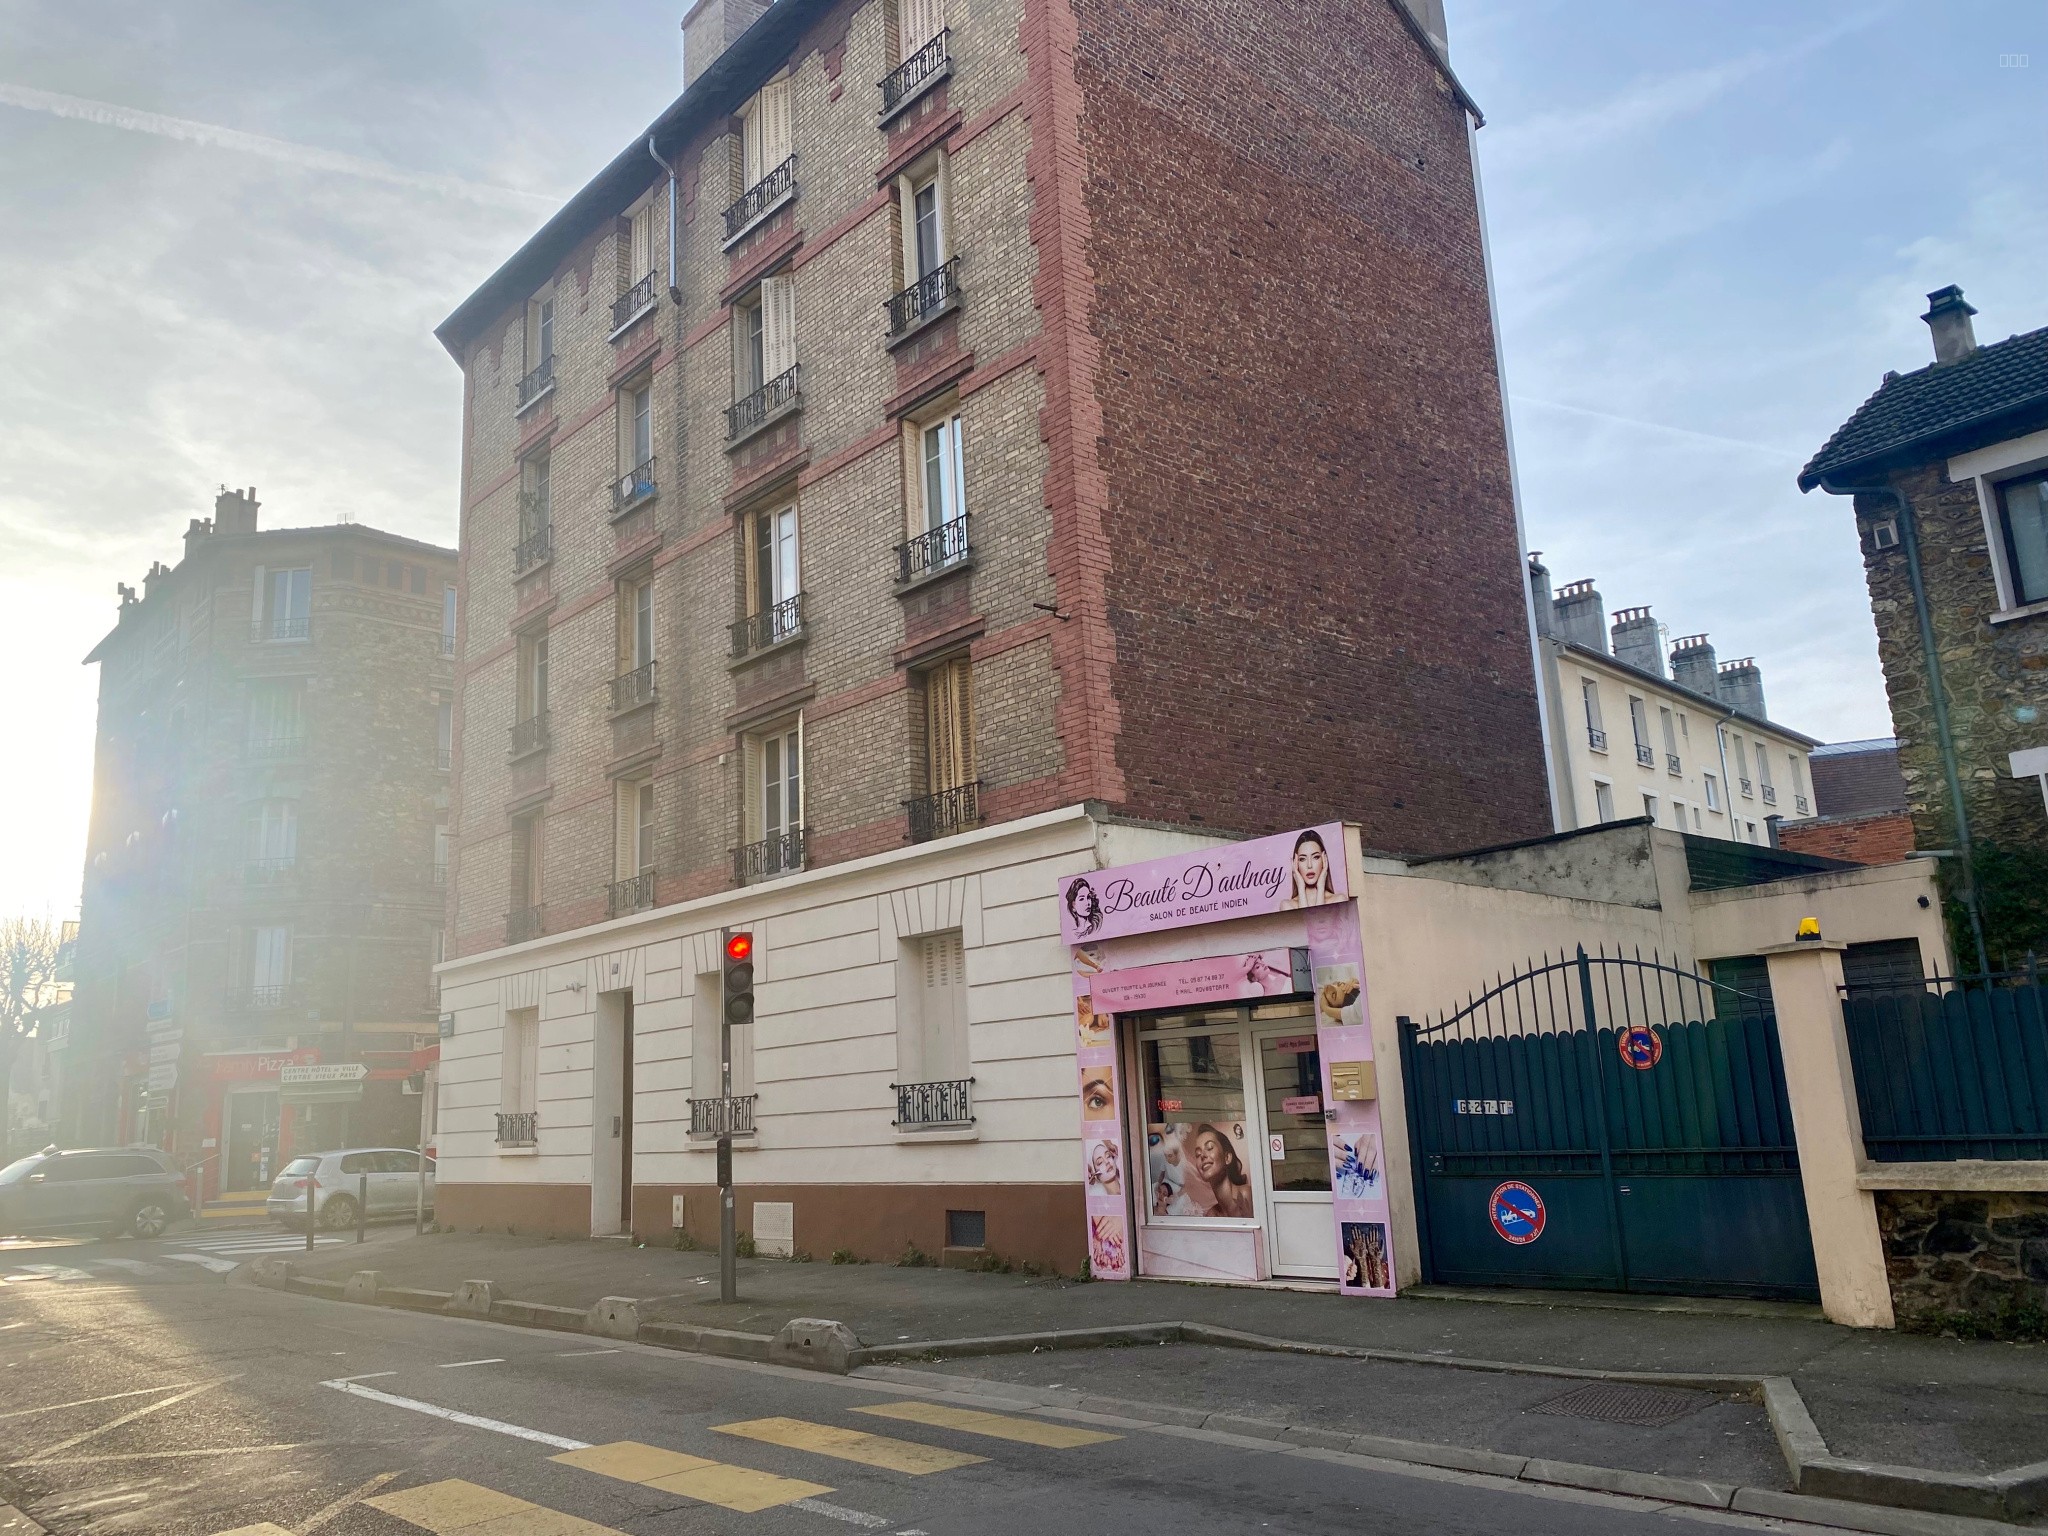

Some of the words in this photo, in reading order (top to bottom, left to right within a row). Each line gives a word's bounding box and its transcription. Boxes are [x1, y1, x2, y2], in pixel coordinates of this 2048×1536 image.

[1104, 878, 1178, 915] Beauté
[1182, 861, 1286, 901] D'aulnay
[1149, 911, 1174, 922] SALON
[1176, 907, 1187, 917] DE
[1221, 898, 1249, 910] INDIEN
[283, 1066, 311, 1074] CENTRE
[311, 1065, 332, 1073] HÔTEL
[283, 1073, 311, 1081] CENTRE
[315, 1072, 336, 1080] VIEUX
[340, 1071, 357, 1079] PAYS
